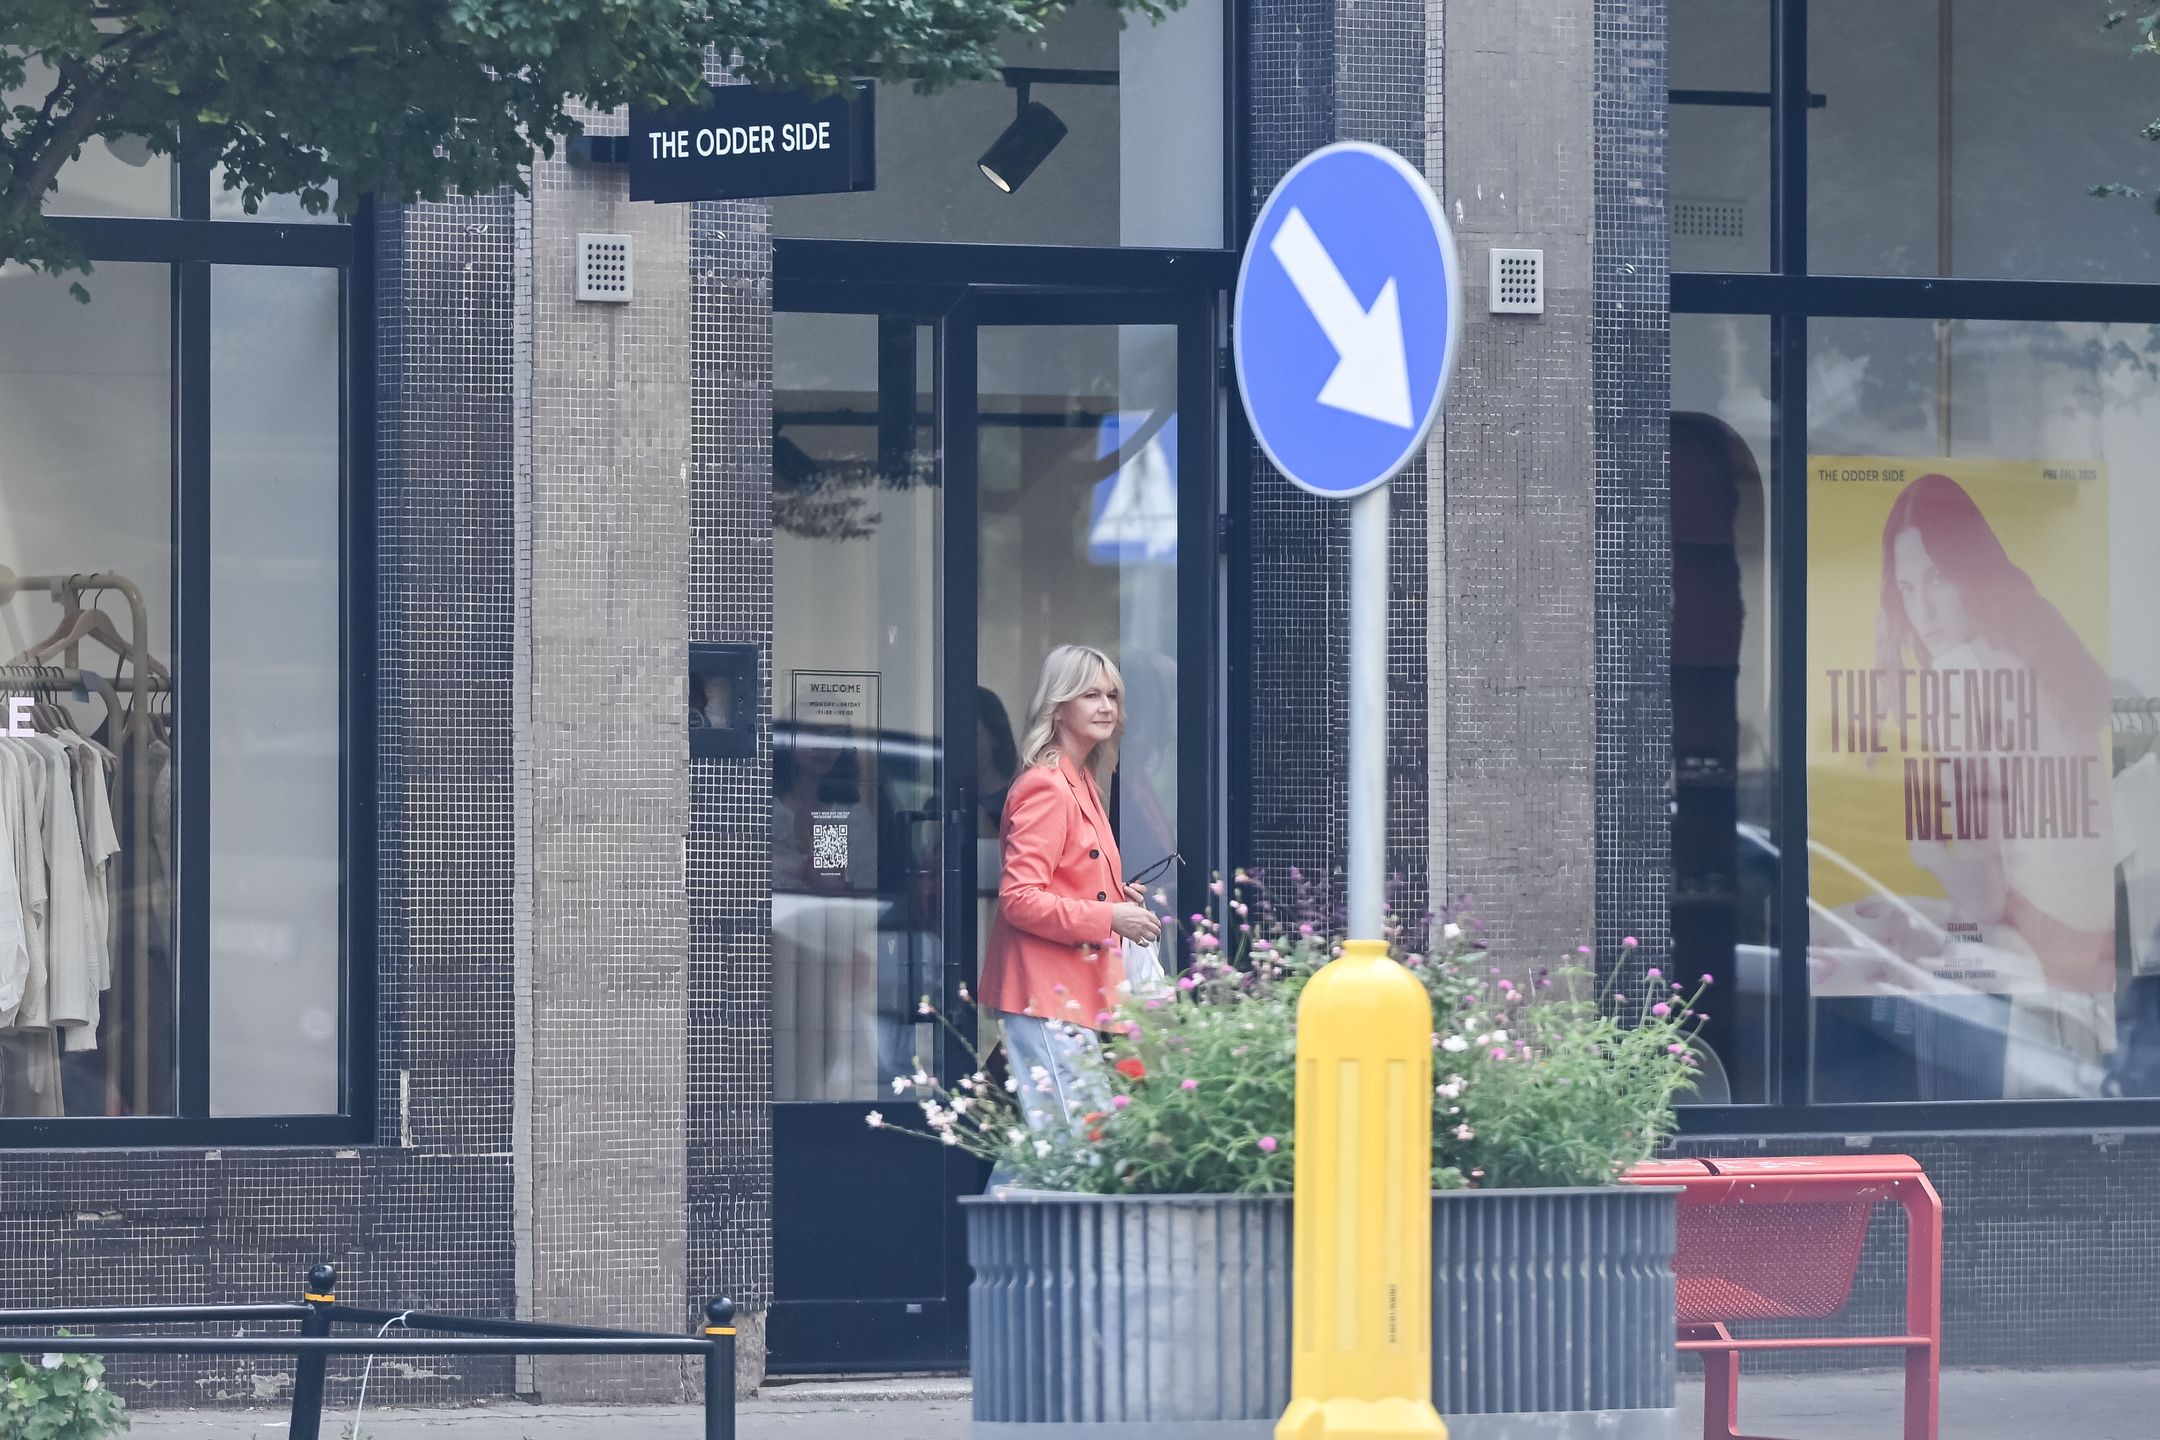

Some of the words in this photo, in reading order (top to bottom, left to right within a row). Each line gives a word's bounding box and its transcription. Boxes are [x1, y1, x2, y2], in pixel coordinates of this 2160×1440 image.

[649, 130, 689, 159] THE
[696, 125, 775, 157] ODDER
[781, 121, 831, 152] SIDE
[1818, 469, 1838, 481] THE
[1841, 469, 1879, 481] ODDER
[1881, 469, 1905, 482] SIDE
[810, 683, 861, 693] WELCOME
[0, 696, 35, 738] E
[1826, 669, 1888, 753] THE
[1899, 668, 2039, 752] FRENCH
[1904, 757, 1989, 841] NEW
[2000, 755, 2100, 840] WAVE
